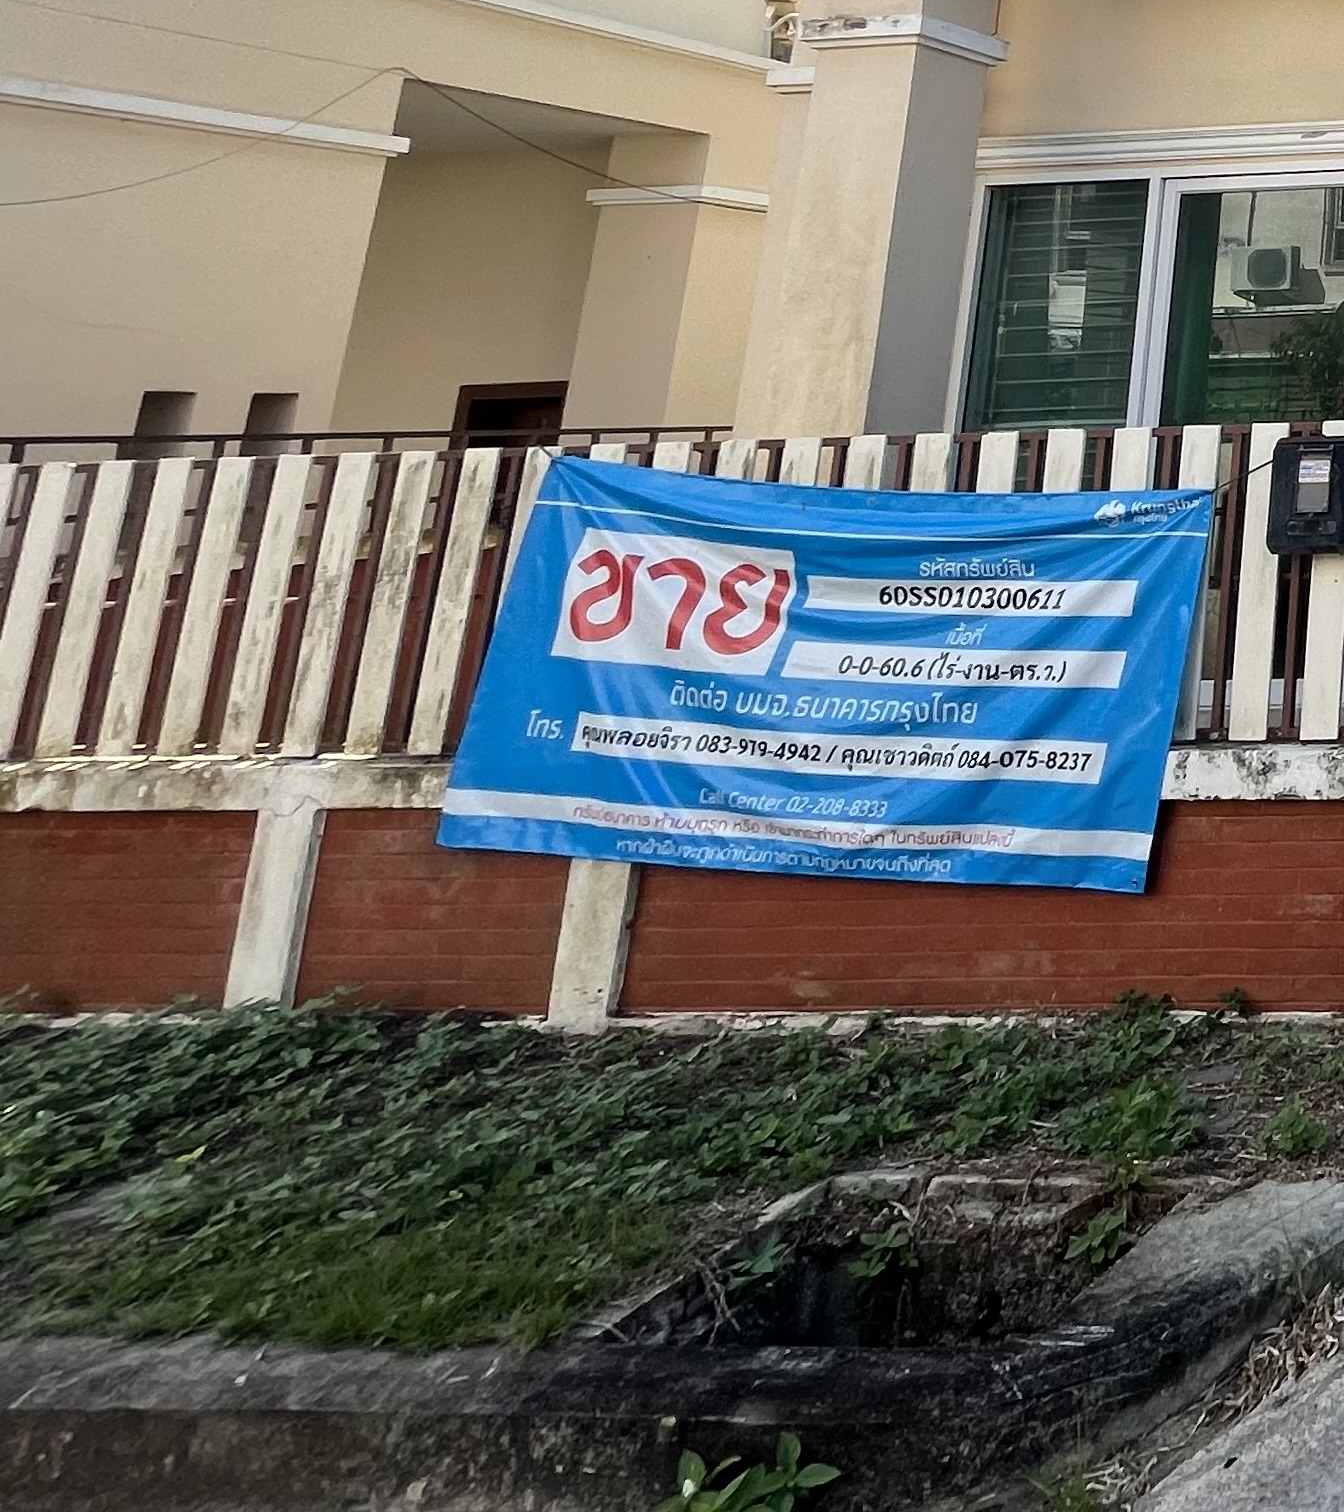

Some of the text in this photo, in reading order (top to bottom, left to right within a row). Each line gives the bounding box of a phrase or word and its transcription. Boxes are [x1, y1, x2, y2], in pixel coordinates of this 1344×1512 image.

[1130, 495, 1203, 515] Krungtha
[919, 556, 1036, 578] รหัสทรัพย์สิน
[569, 549, 791, 656] ขาย
[878, 585, 1067, 611] 60SS010300611
[944, 622, 988, 646] เนื้อที่
[669, 679, 729, 712] ติดต่อ
[526, 708, 565, 740] โทร.
[957, 750, 1092, 772] 084-075-8237
[700, 787, 888, 819] Call Center 02-208-8333
